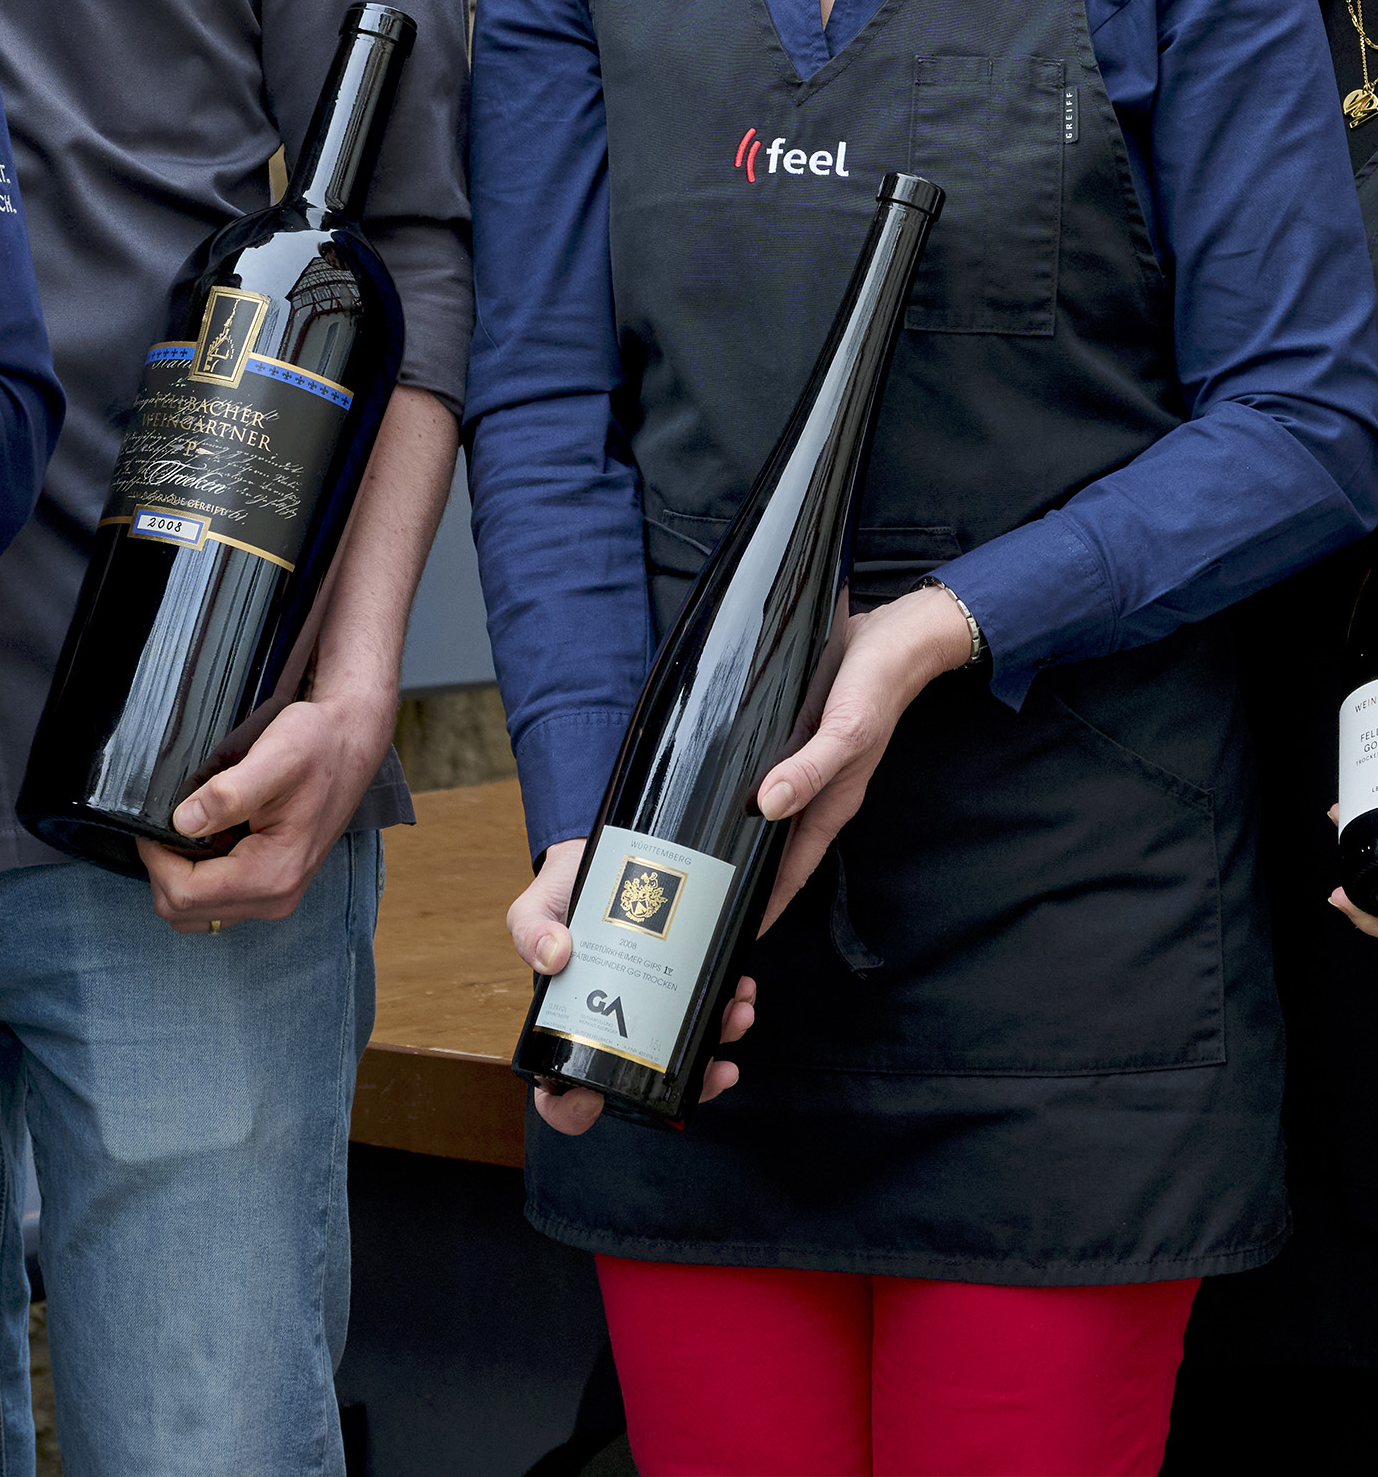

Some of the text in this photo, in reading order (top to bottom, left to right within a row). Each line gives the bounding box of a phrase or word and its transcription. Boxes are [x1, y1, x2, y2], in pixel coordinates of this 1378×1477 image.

[1065, 92, 1073, 139] GREIFF
[766, 137, 850, 177] feel
[153, 392, 265, 429] FELLBACHER
[141, 412, 272, 452] WEINGÄRTNER
[147, 517, 183, 533] 2008
[630, 840, 693, 866] WÜRTTEMBERG
[579, 940, 643, 966] UNTERTÜRKHEIMER
[643, 959, 662, 972] GIPS
[619, 938, 637, 950] 2008
[642, 971, 678, 991] TROCKEN
